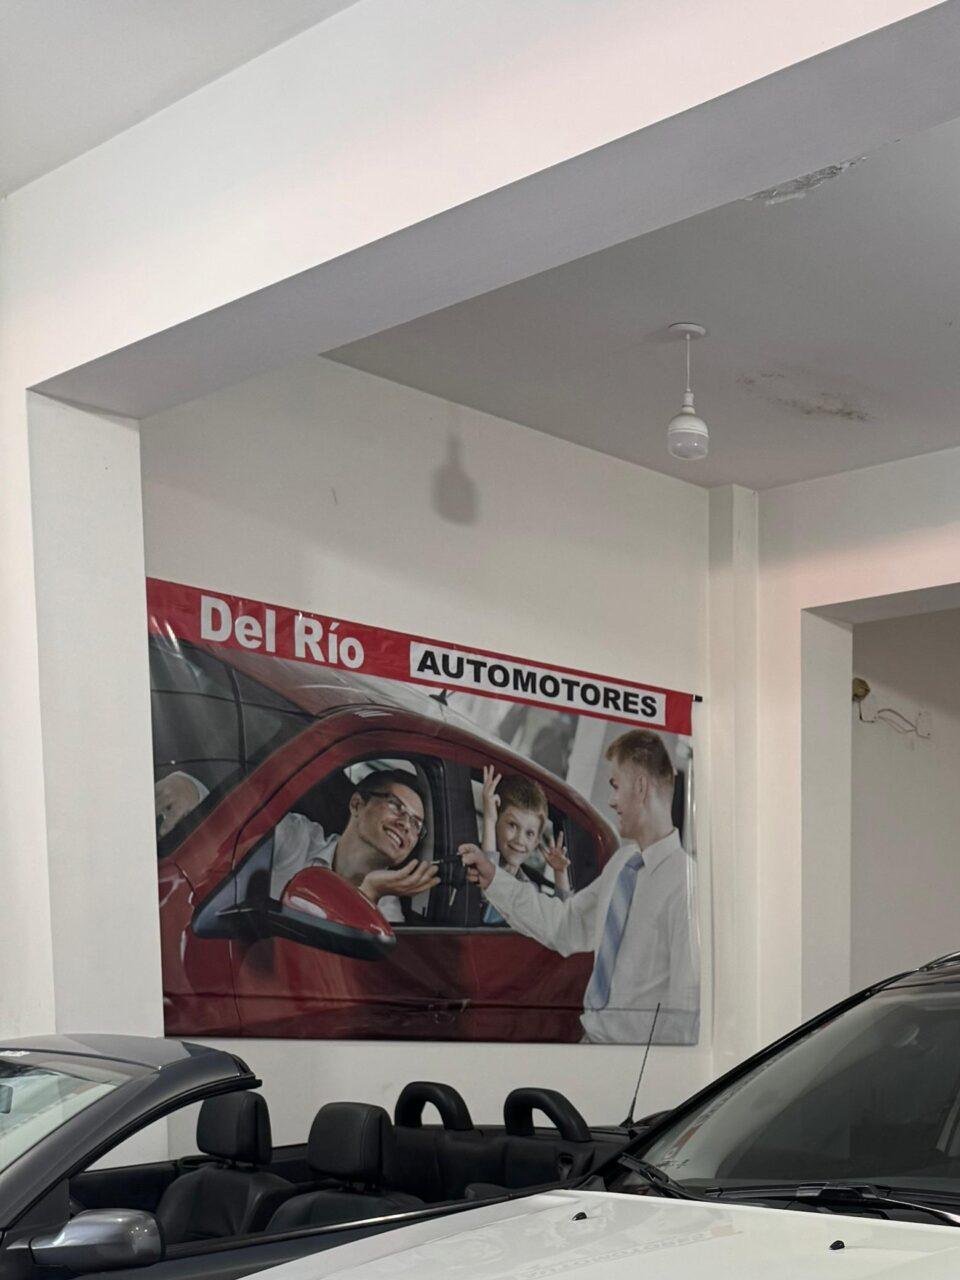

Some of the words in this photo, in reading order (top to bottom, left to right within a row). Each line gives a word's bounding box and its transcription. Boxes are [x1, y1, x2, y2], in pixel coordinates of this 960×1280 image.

[200, 594, 277, 653] Del
[294, 612, 365, 669] Río
[417, 650, 657, 718] AUTOMOTORES
